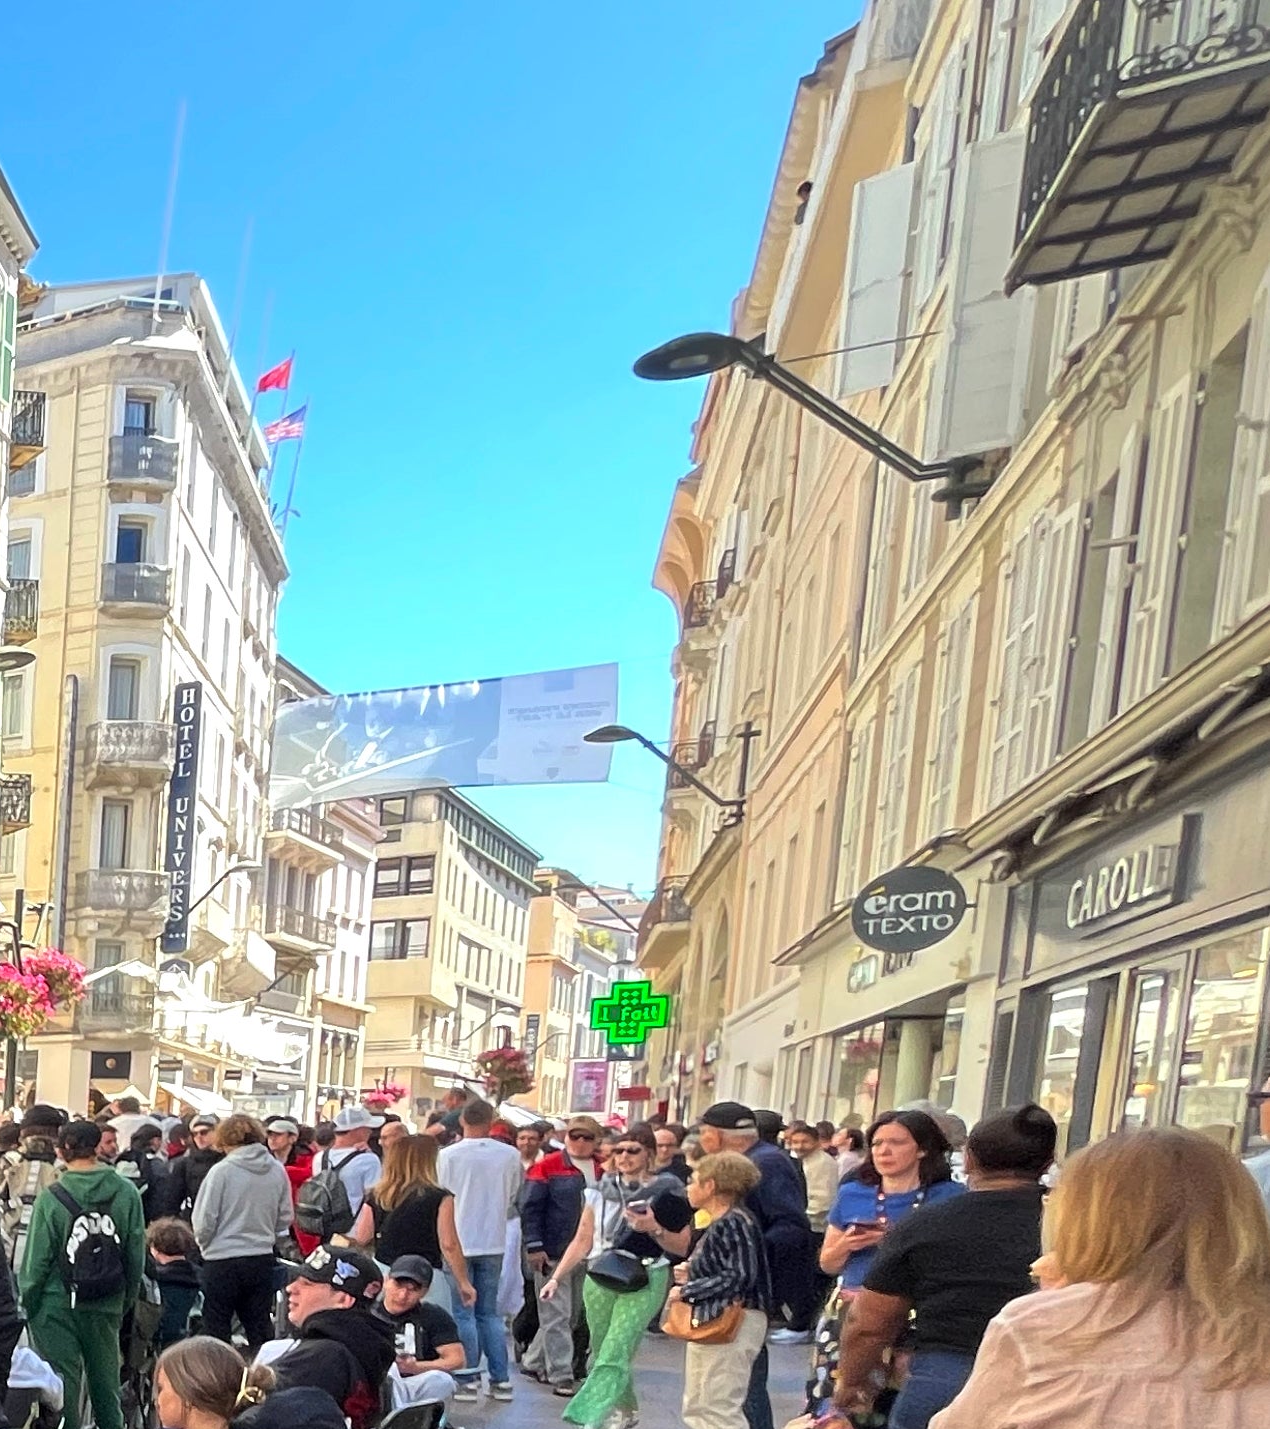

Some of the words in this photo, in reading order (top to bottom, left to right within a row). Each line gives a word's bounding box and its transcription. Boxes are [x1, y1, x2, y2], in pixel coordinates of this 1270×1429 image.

[177, 688, 195, 778] HOTEL
[169, 797, 189, 922] UNIVERS
[863, 914, 954, 935] TEXTO
